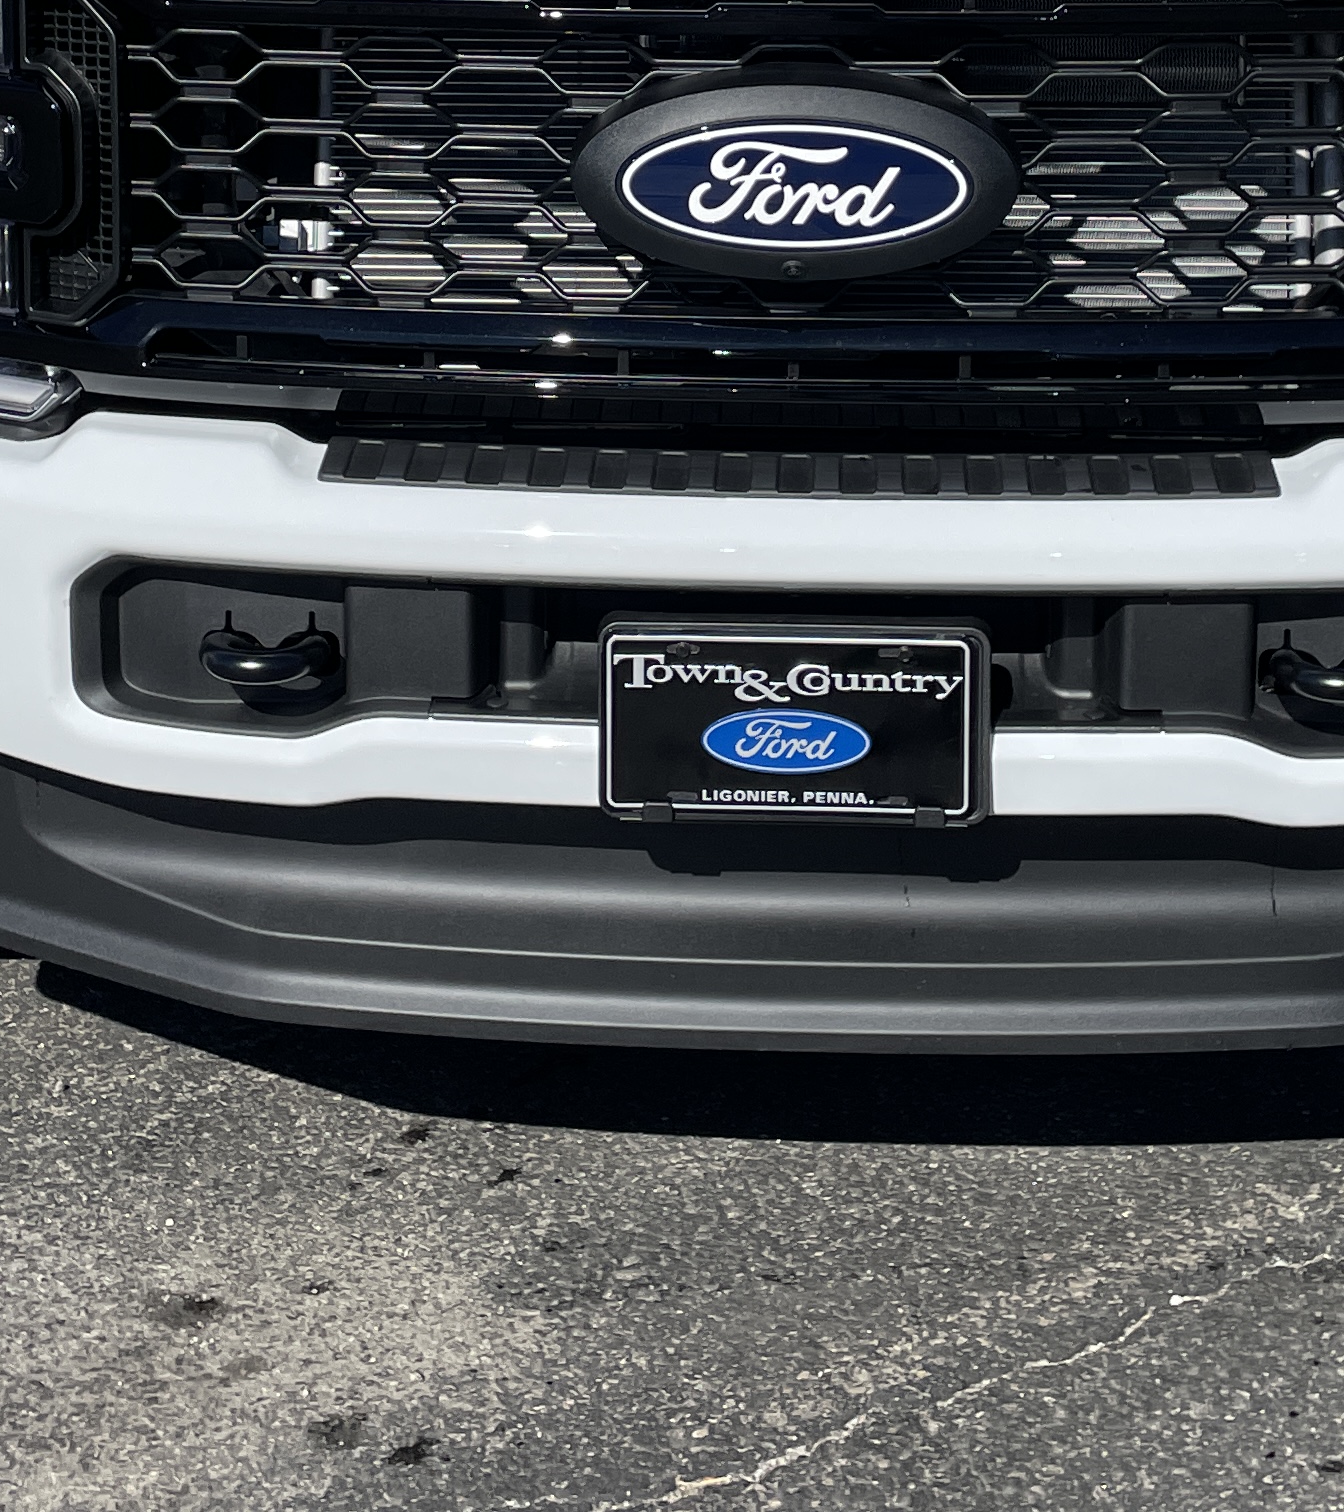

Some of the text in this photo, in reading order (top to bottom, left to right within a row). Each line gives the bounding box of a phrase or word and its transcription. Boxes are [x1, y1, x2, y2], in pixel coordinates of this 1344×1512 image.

[688, 141, 902, 227] Ford
[613, 654, 747, 688] Town
[734, 669, 791, 703] &
[735, 718, 837, 760] Ford
[701, 789, 875, 806] LIGONIER, PENNA.
